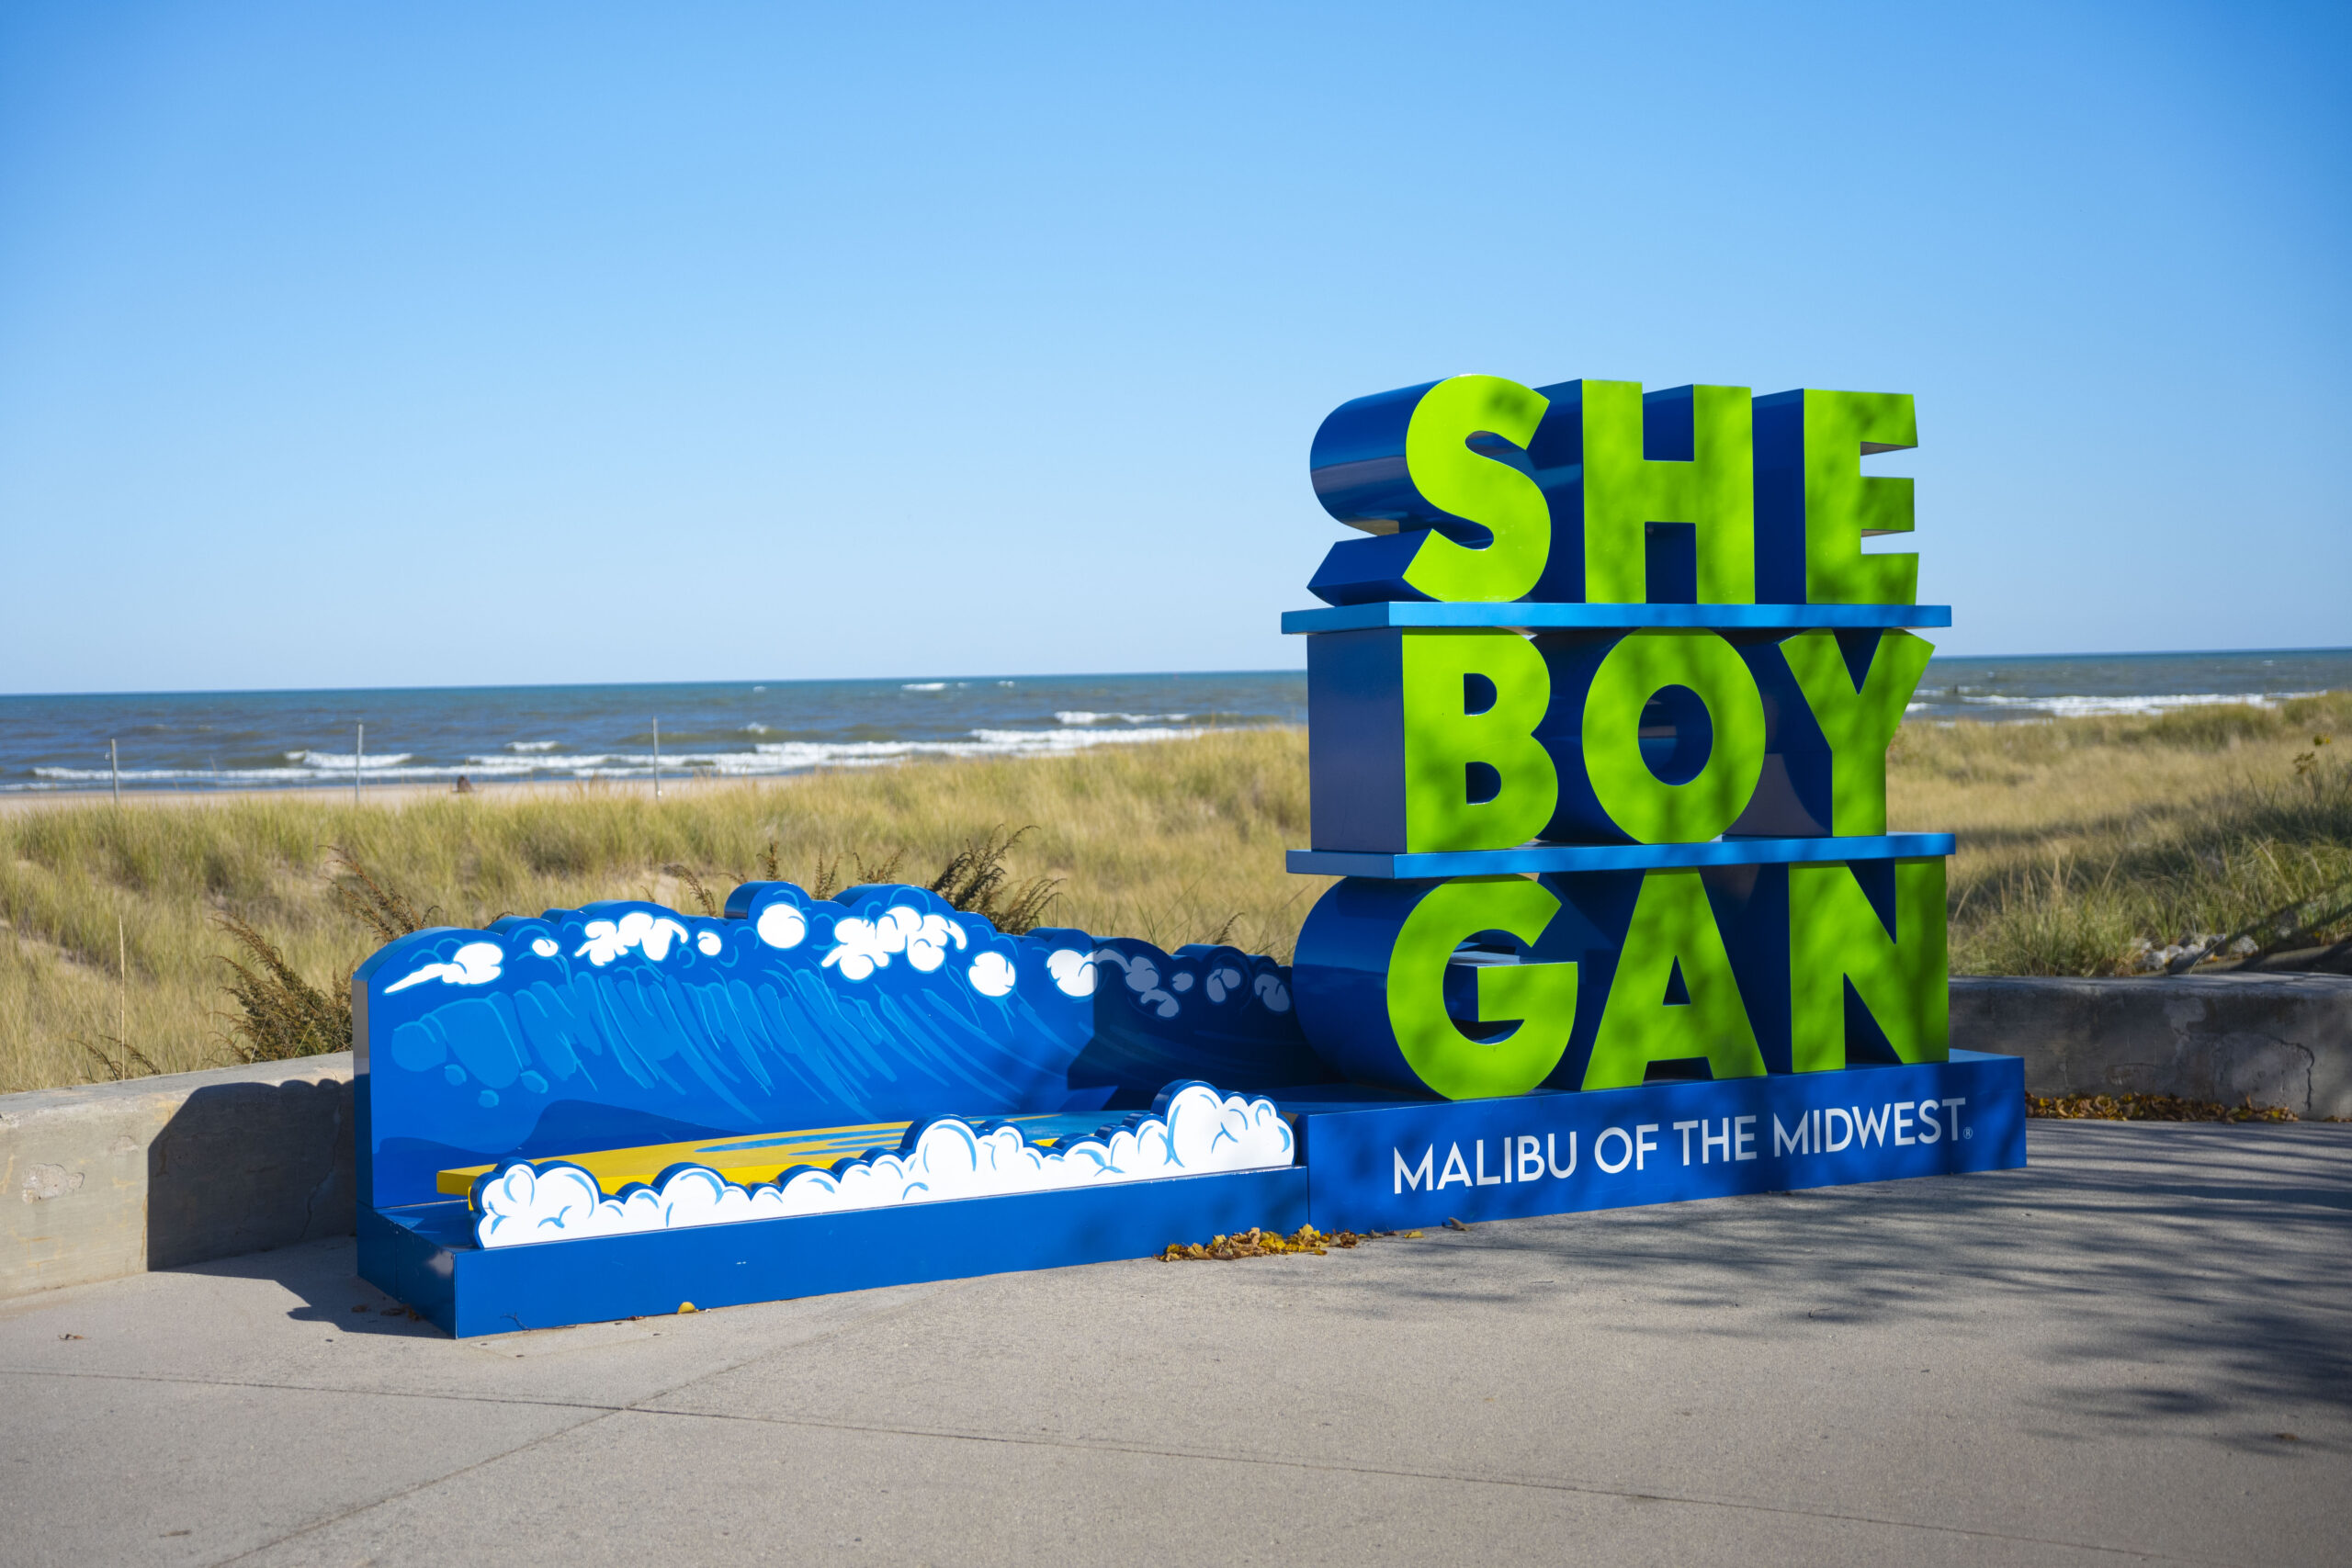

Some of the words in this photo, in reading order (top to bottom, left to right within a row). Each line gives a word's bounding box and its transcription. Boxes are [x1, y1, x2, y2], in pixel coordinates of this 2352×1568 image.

[1402, 374, 1919, 605] SHE
[1402, 626, 1936, 853] BOY
[1386, 855, 1949, 1100] GAN
[1393, 1130, 1577, 1194] MALIBU
[1594, 1122, 1659, 1175] OF
[1673, 1114, 1758, 1166] THE
